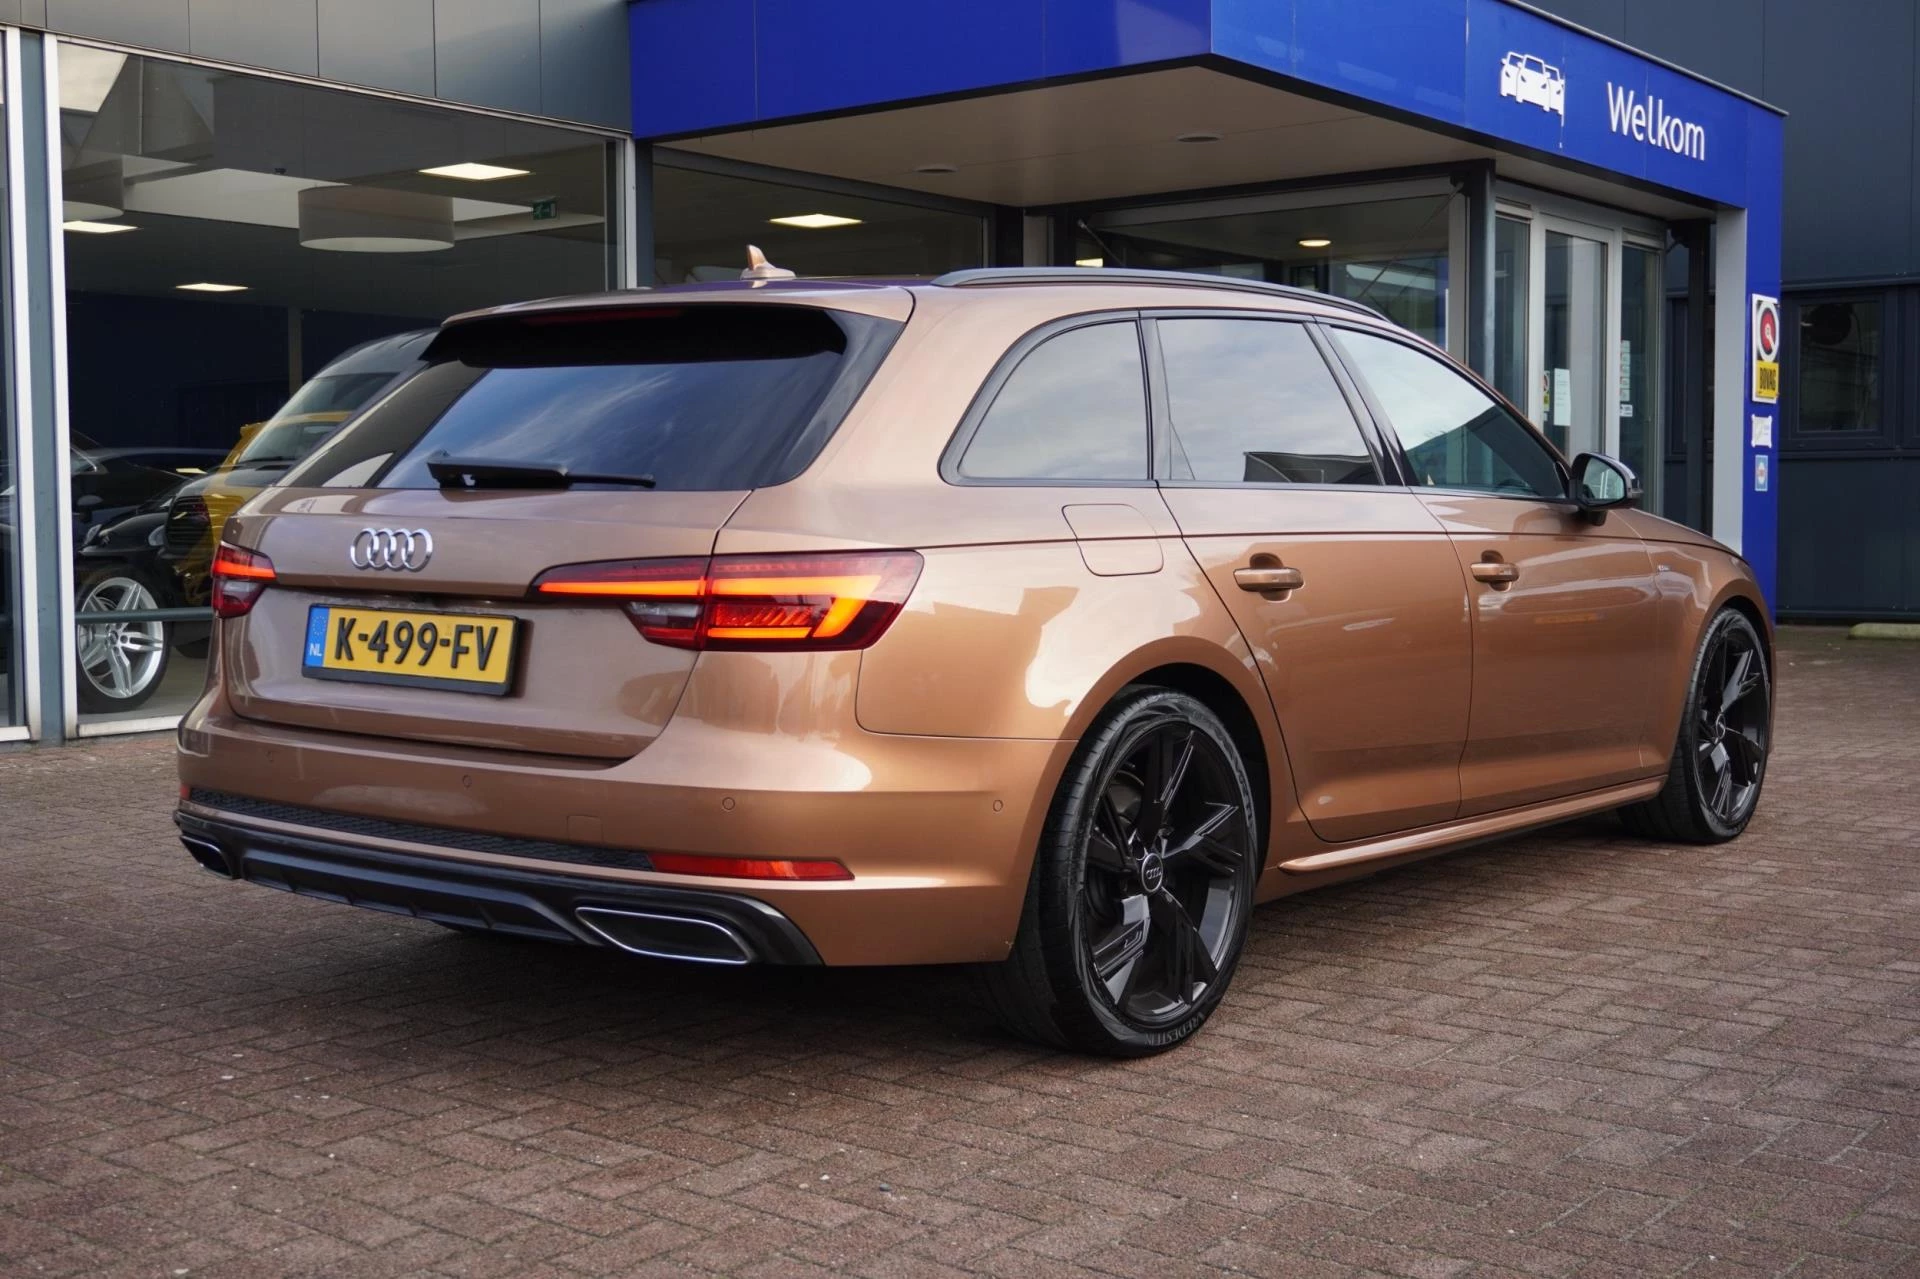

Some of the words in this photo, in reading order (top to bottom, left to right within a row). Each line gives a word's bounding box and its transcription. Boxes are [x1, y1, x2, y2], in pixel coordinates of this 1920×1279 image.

[1606, 81, 1705, 161] Welkom
[1759, 367, 1777, 391] BOVAG
[309, 643, 322, 657] NL
[334, 617, 499, 671] K-499-FV
